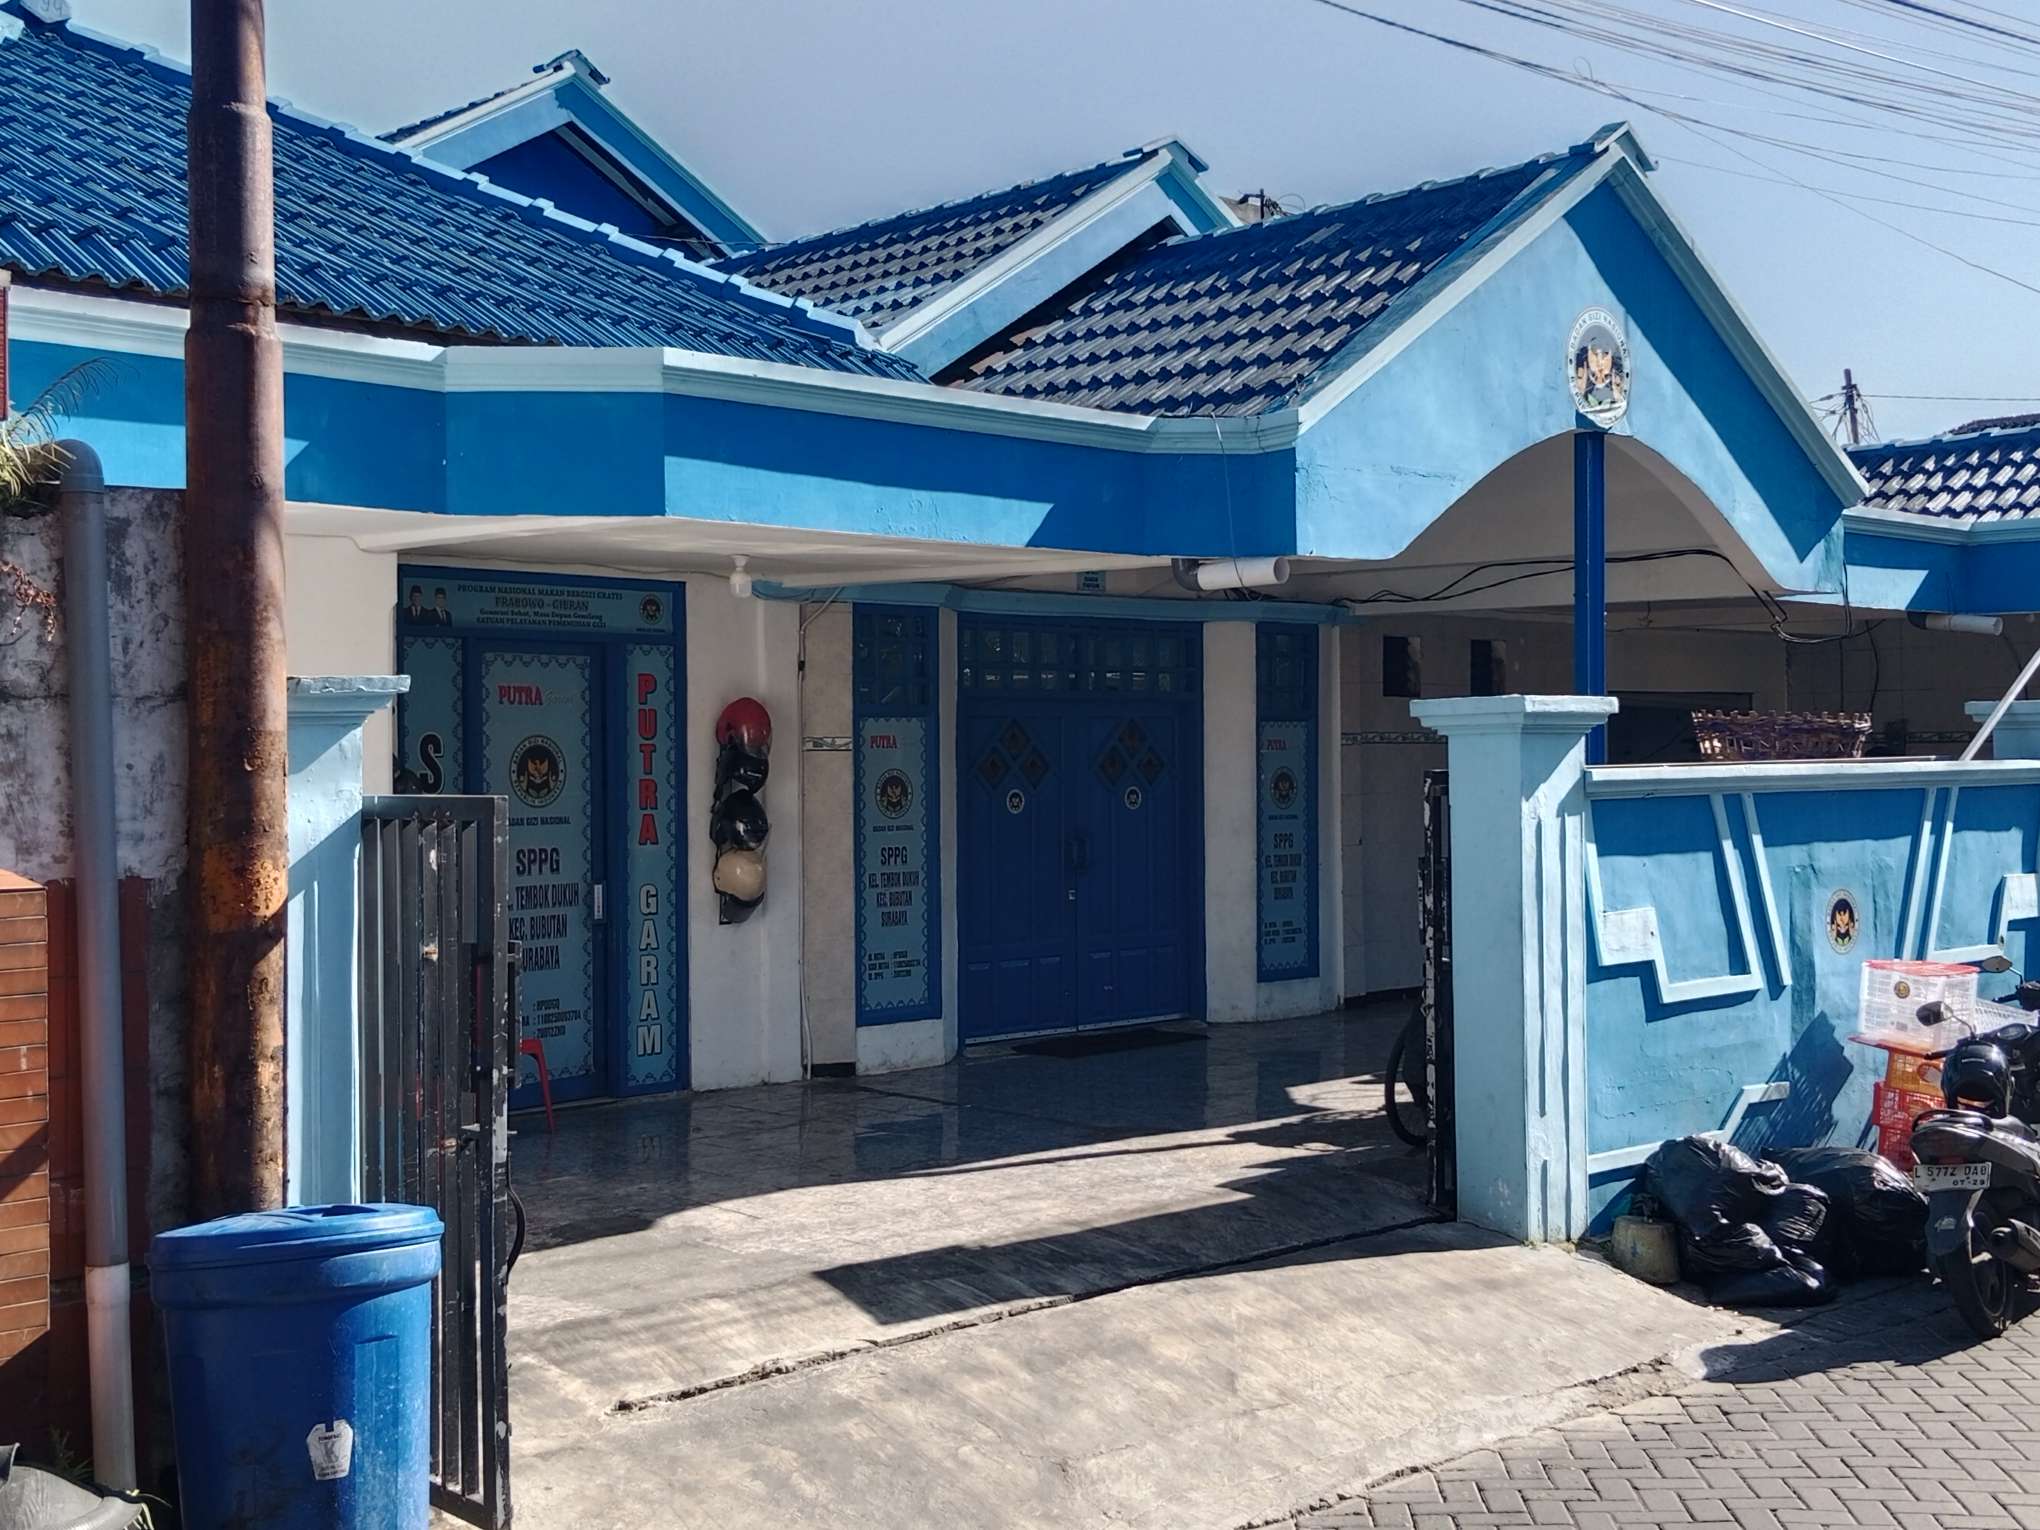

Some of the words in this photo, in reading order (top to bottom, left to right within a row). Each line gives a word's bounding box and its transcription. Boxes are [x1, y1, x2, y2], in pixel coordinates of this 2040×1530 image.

[495, 596, 545, 609] PRABOWO
[552, 598, 590, 611] GIBRAN
[497, 685, 544, 706] PUTRA
[870, 735, 898, 749] PUTRA
[637, 672, 659, 846] PUTRA
[508, 817, 525, 827] ADAN
[1273, 832, 1294, 849] SPPG
[515, 847, 560, 876] SPPG
[880, 846, 908, 866] SPPG
[515, 884, 550, 911] TEMBOK
[551, 882, 580, 909] DUKUH
[529, 913, 568, 941] BUBUTAN
[522, 945, 560, 972] URABAYA
[636, 884, 663, 1057] GARAM
[1915, 1167, 1921, 1178] L
[1927, 1166, 1957, 1177] 5772
